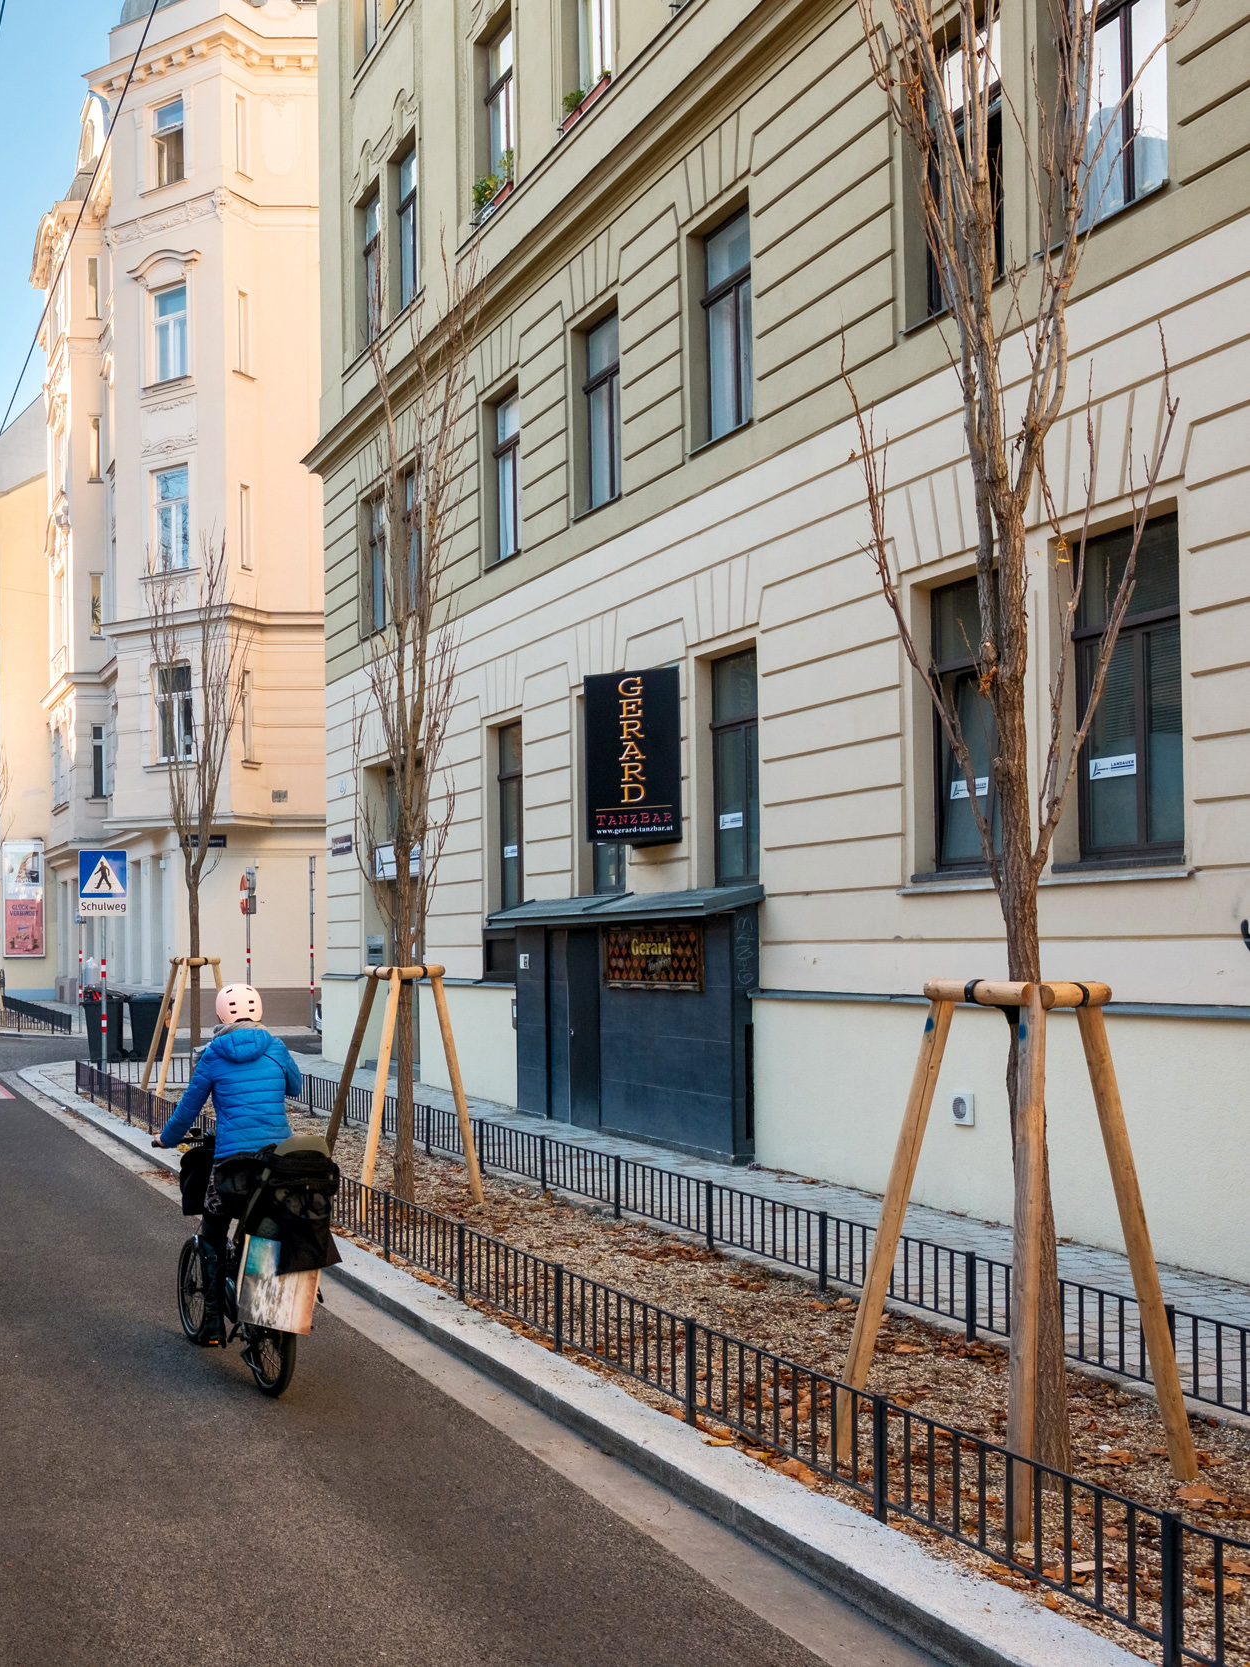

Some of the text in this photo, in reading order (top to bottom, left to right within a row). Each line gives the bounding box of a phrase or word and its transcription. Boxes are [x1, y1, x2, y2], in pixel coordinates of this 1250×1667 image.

[618, 676, 646, 803] GERARD
[596, 824, 674, 836] www.gerard-tanzbar.at
[80, 901, 127, 913] Schulweg
[631, 938, 672, 956] Gerard
